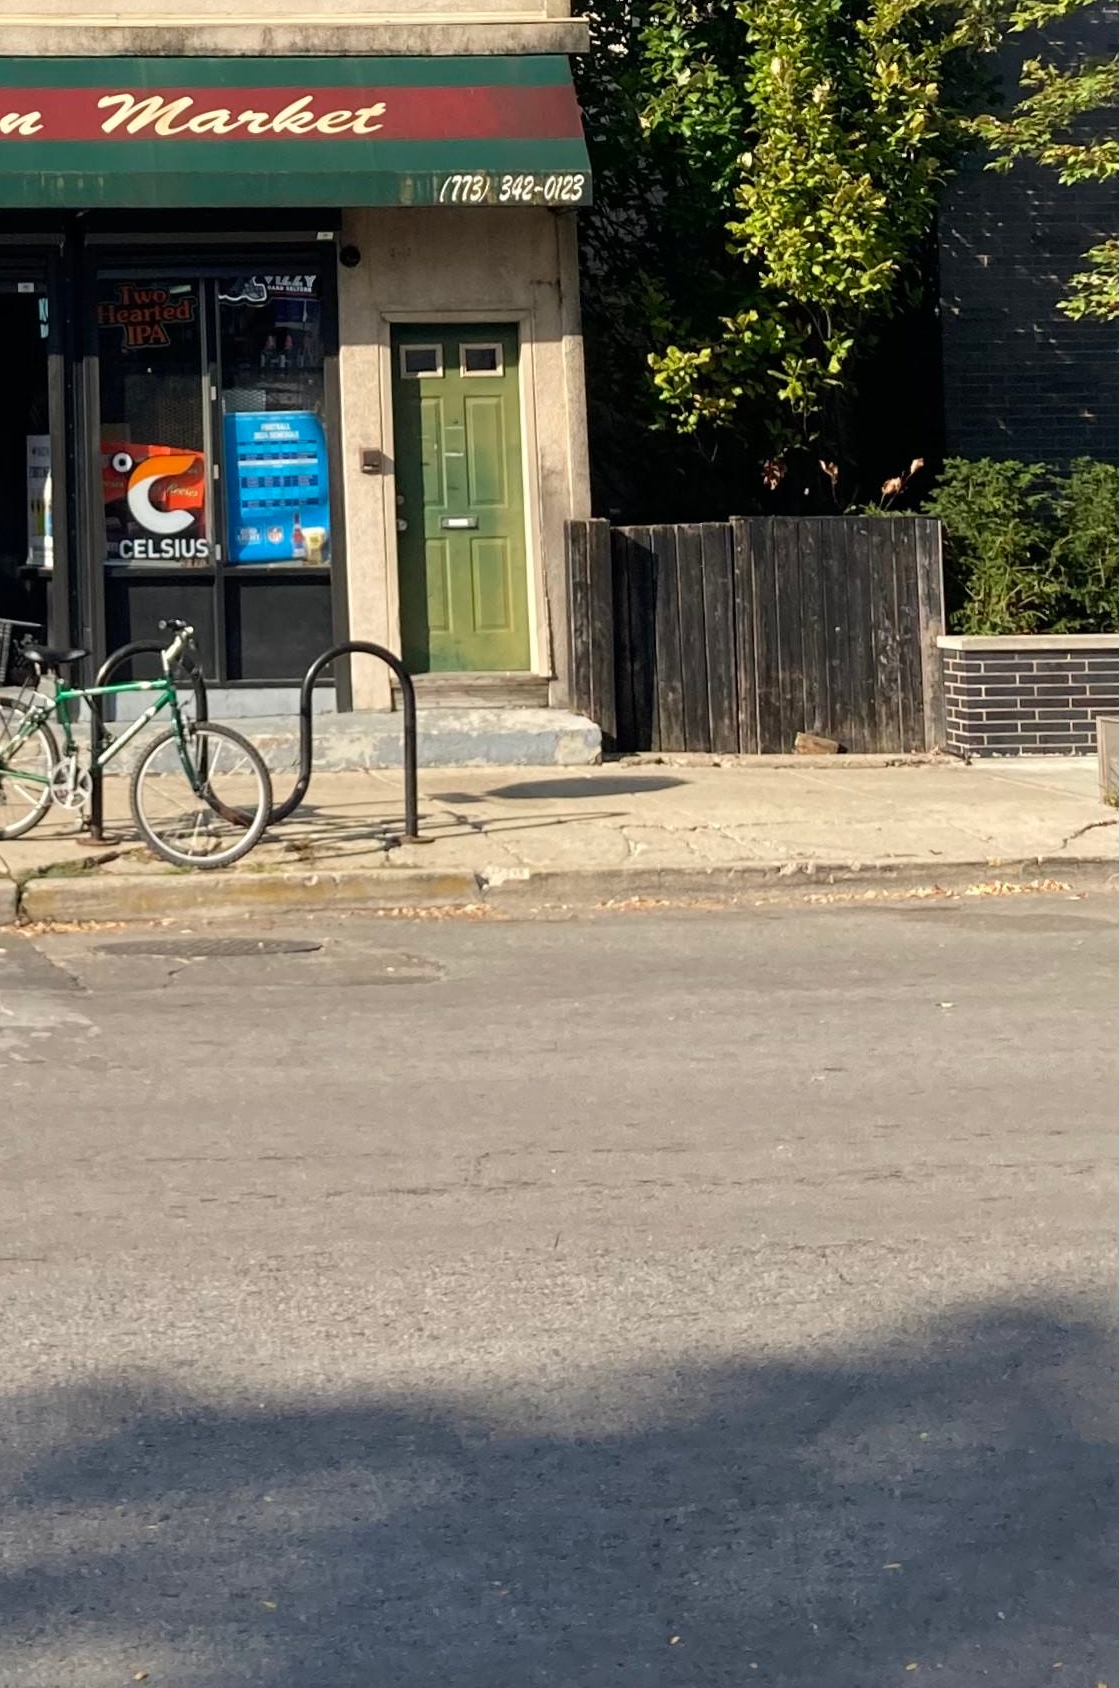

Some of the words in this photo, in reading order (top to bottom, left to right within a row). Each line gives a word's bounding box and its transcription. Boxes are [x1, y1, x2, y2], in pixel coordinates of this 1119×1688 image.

[98, 93, 387, 135] Market
[439, 174, 490, 202] (773)
[499, 173, 585, 202] 342-0123
[117, 284, 168, 305] Two
[98, 299, 194, 323] Hearted
[127, 323, 167, 345] IPA
[119, 539, 209, 559] CELSIUS
